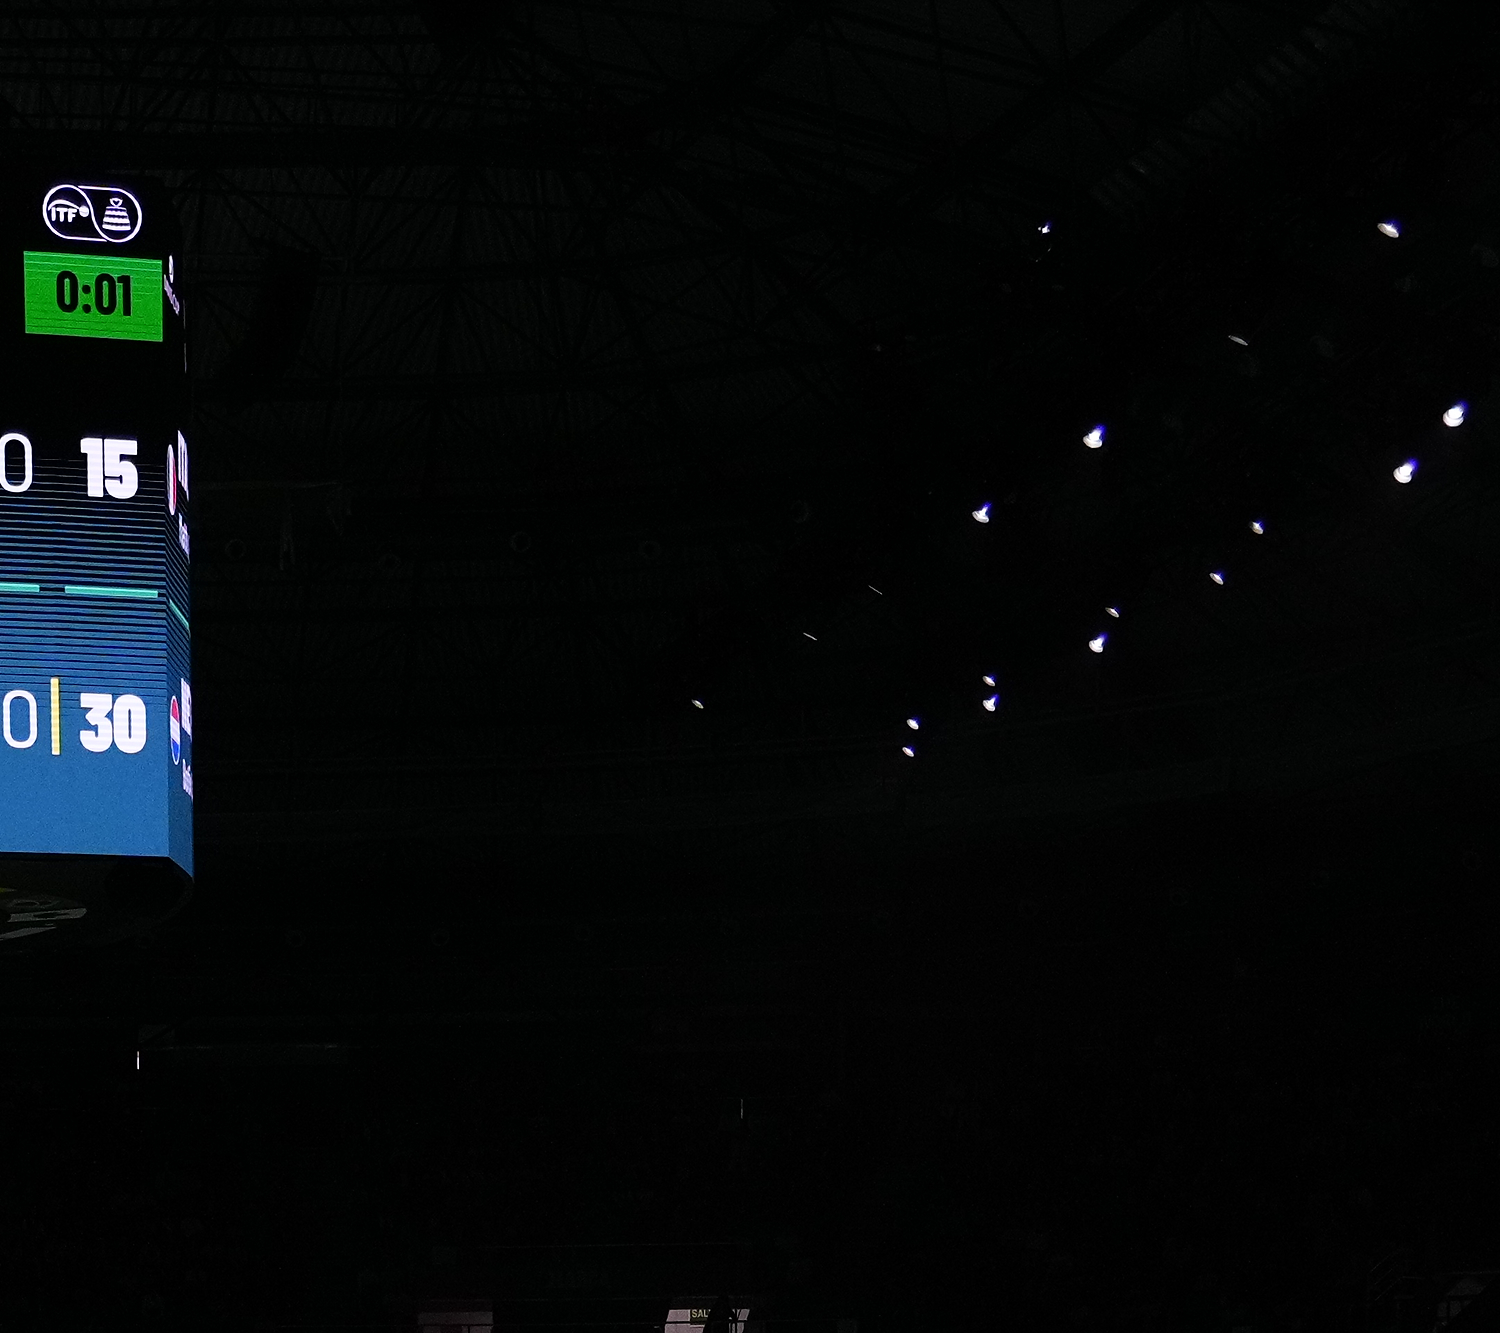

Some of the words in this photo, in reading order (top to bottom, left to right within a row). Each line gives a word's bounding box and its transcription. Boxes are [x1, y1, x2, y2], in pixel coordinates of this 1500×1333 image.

[51, 206, 78, 222] ITF
[56, 270, 133, 317] 0:01
[80, 437, 139, 499] 15
[2, 689, 38, 749] 0
[79, 692, 147, 754] 30
